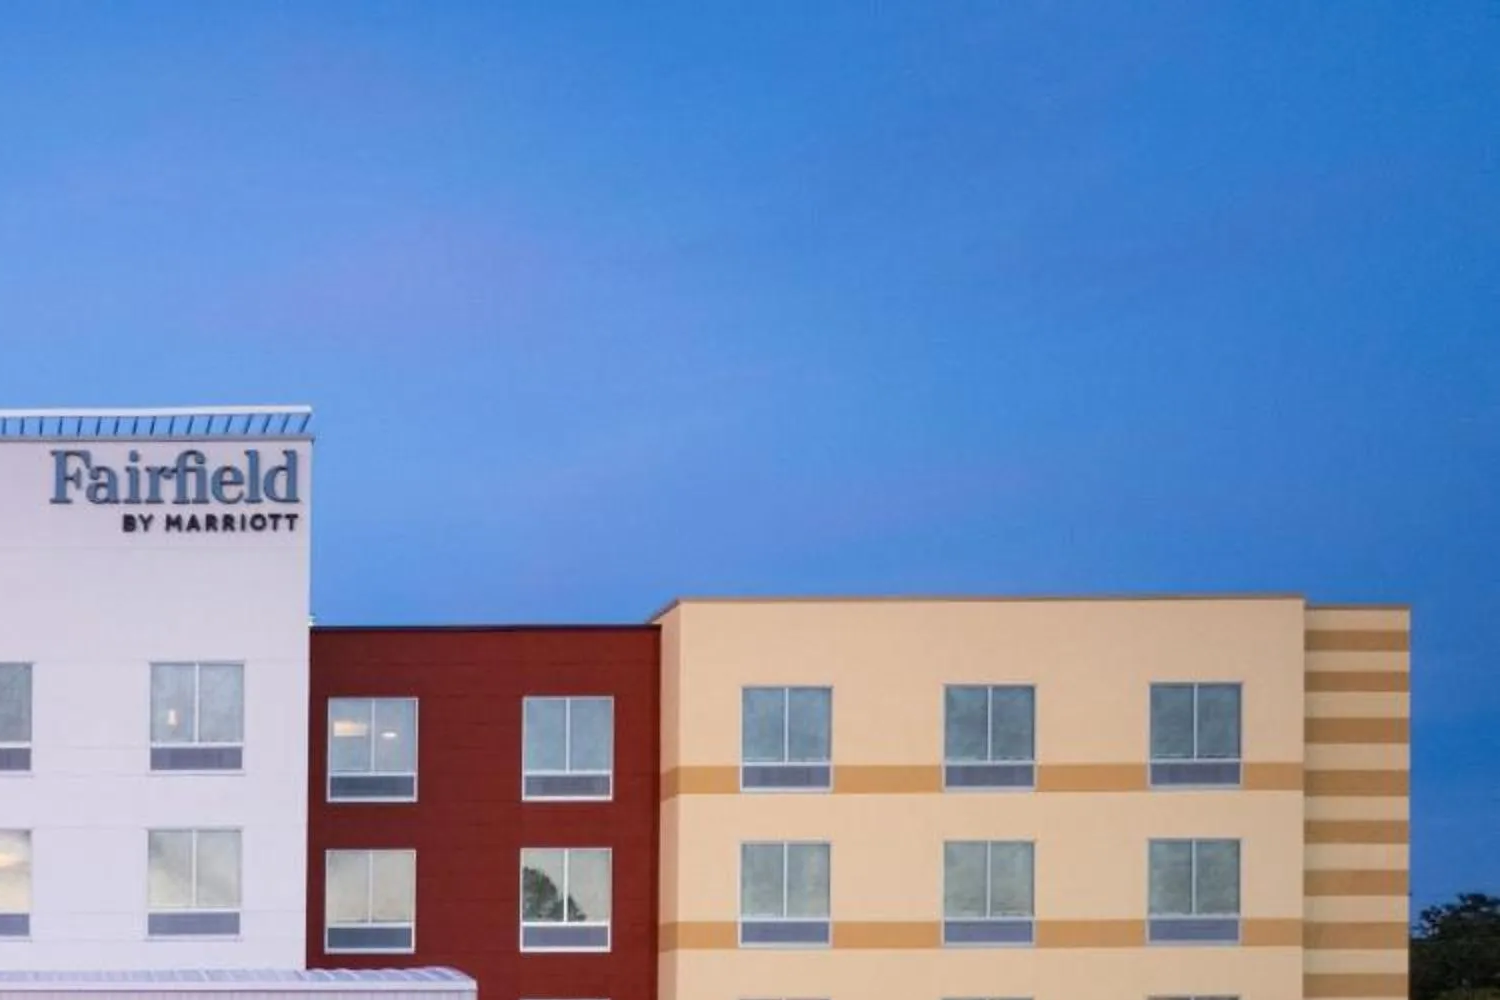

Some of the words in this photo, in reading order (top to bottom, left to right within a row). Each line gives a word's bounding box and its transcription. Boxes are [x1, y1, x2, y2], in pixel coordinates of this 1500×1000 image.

[49, 449, 301, 504] Fairfield
[122, 514, 154, 532] BY
[165, 513, 300, 532] MARRIOTT
